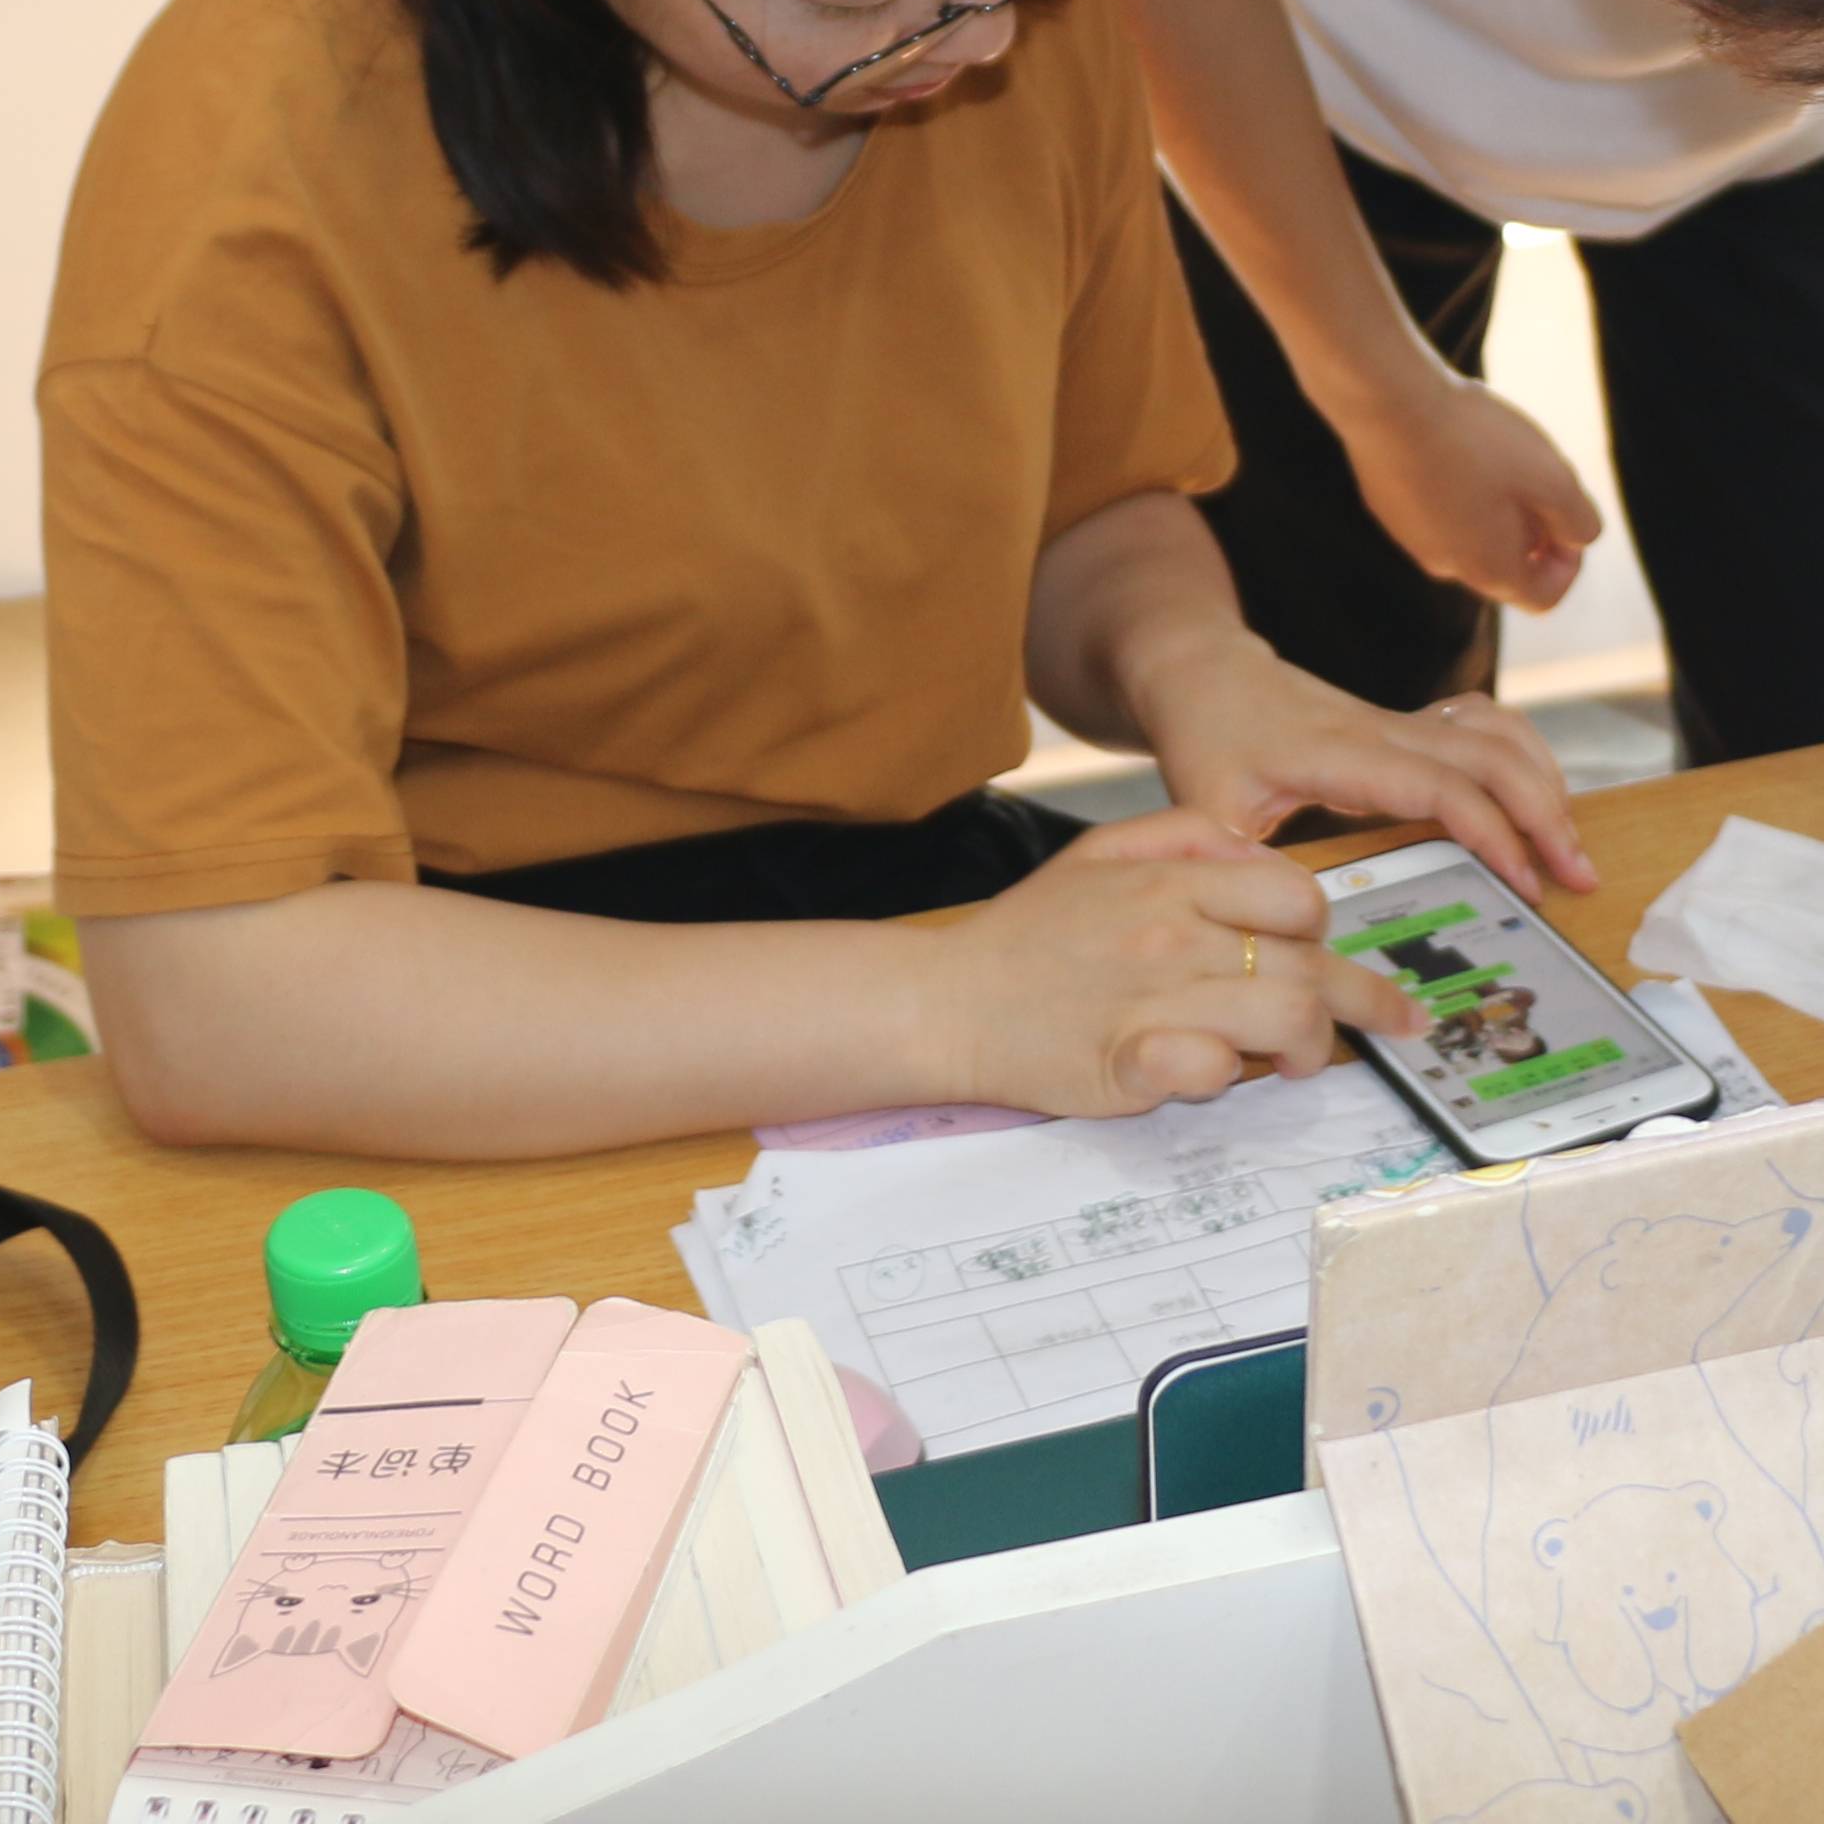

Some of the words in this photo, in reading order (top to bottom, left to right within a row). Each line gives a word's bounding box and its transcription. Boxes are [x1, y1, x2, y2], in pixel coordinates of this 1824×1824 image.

[316, 1442, 475, 1480] 单词本
[495, 1513, 585, 1636] WORD
[573, 1379, 654, 1492] BOOK
